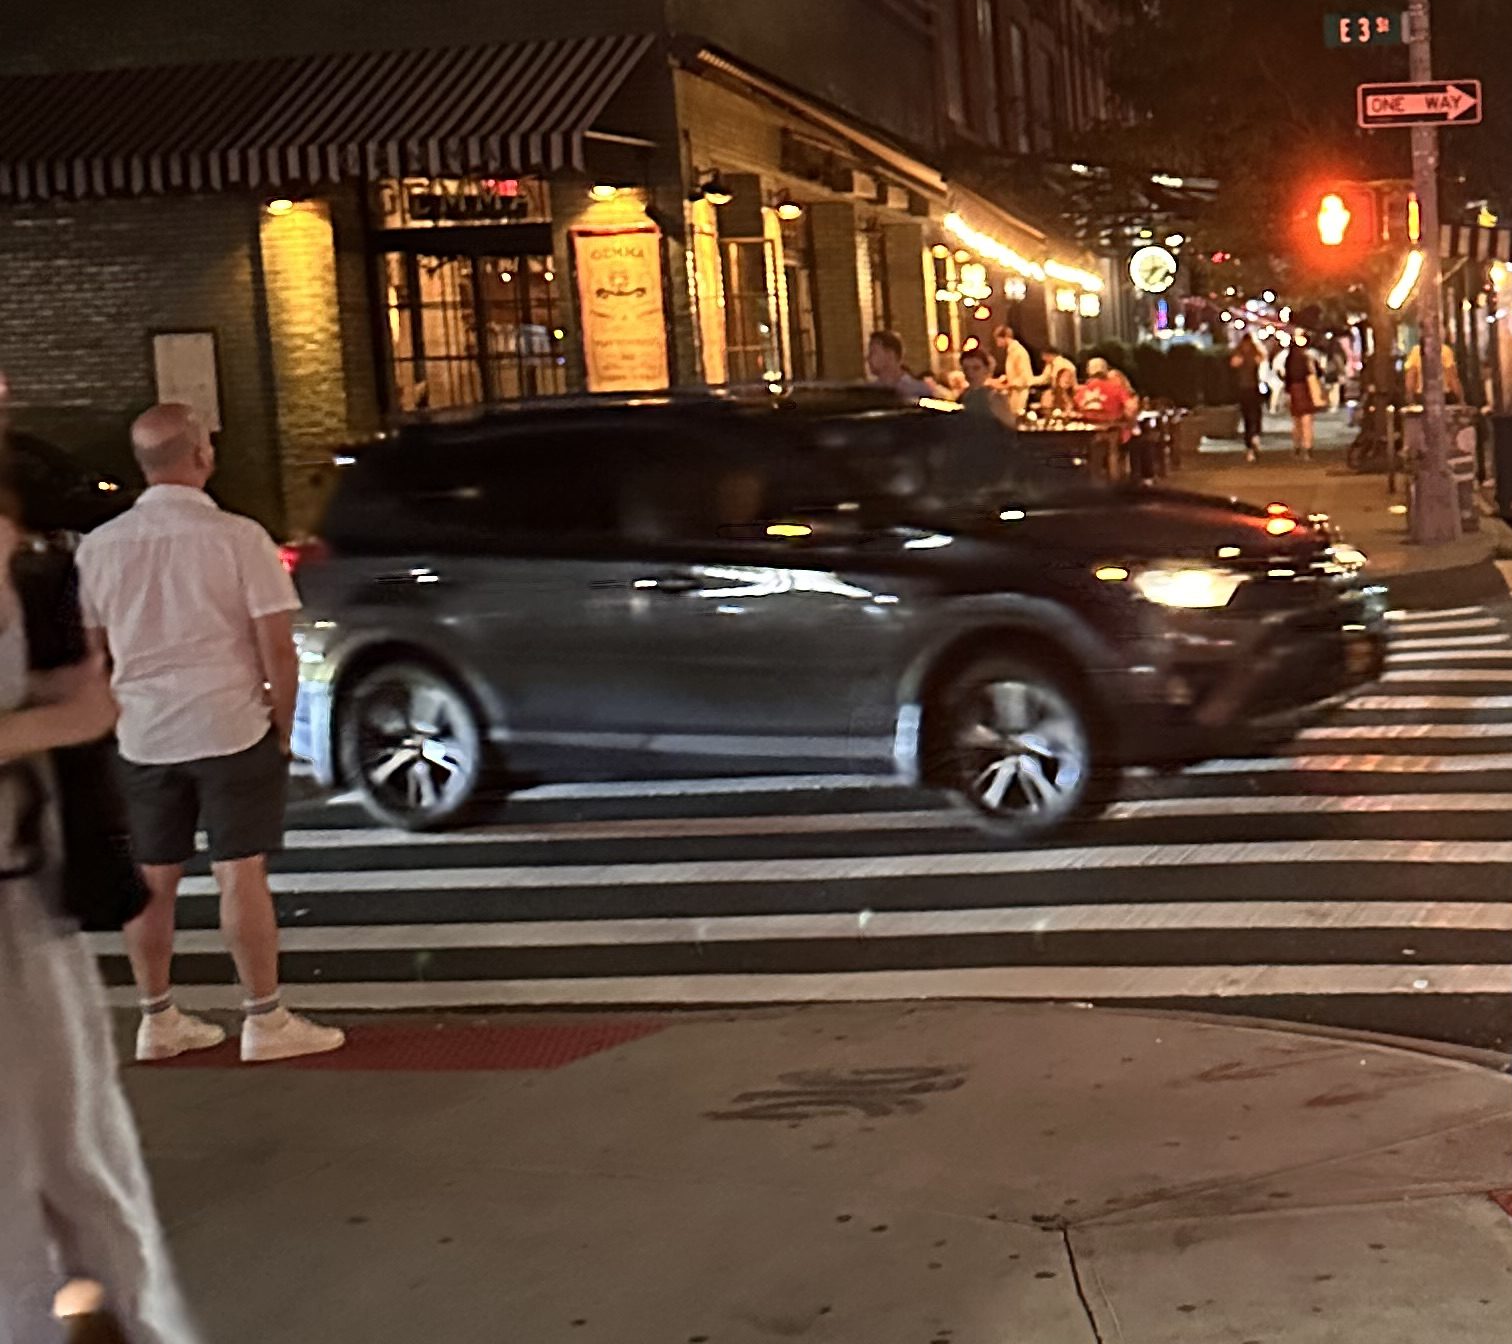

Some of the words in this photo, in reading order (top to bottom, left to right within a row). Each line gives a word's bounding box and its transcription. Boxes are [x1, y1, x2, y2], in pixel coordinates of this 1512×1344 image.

[1340, 17, 1352, 43] E
[1357, 16, 1371, 44] 3
[1371, 96, 1406, 113] ONE
[1424, 94, 1463, 110] WAY
